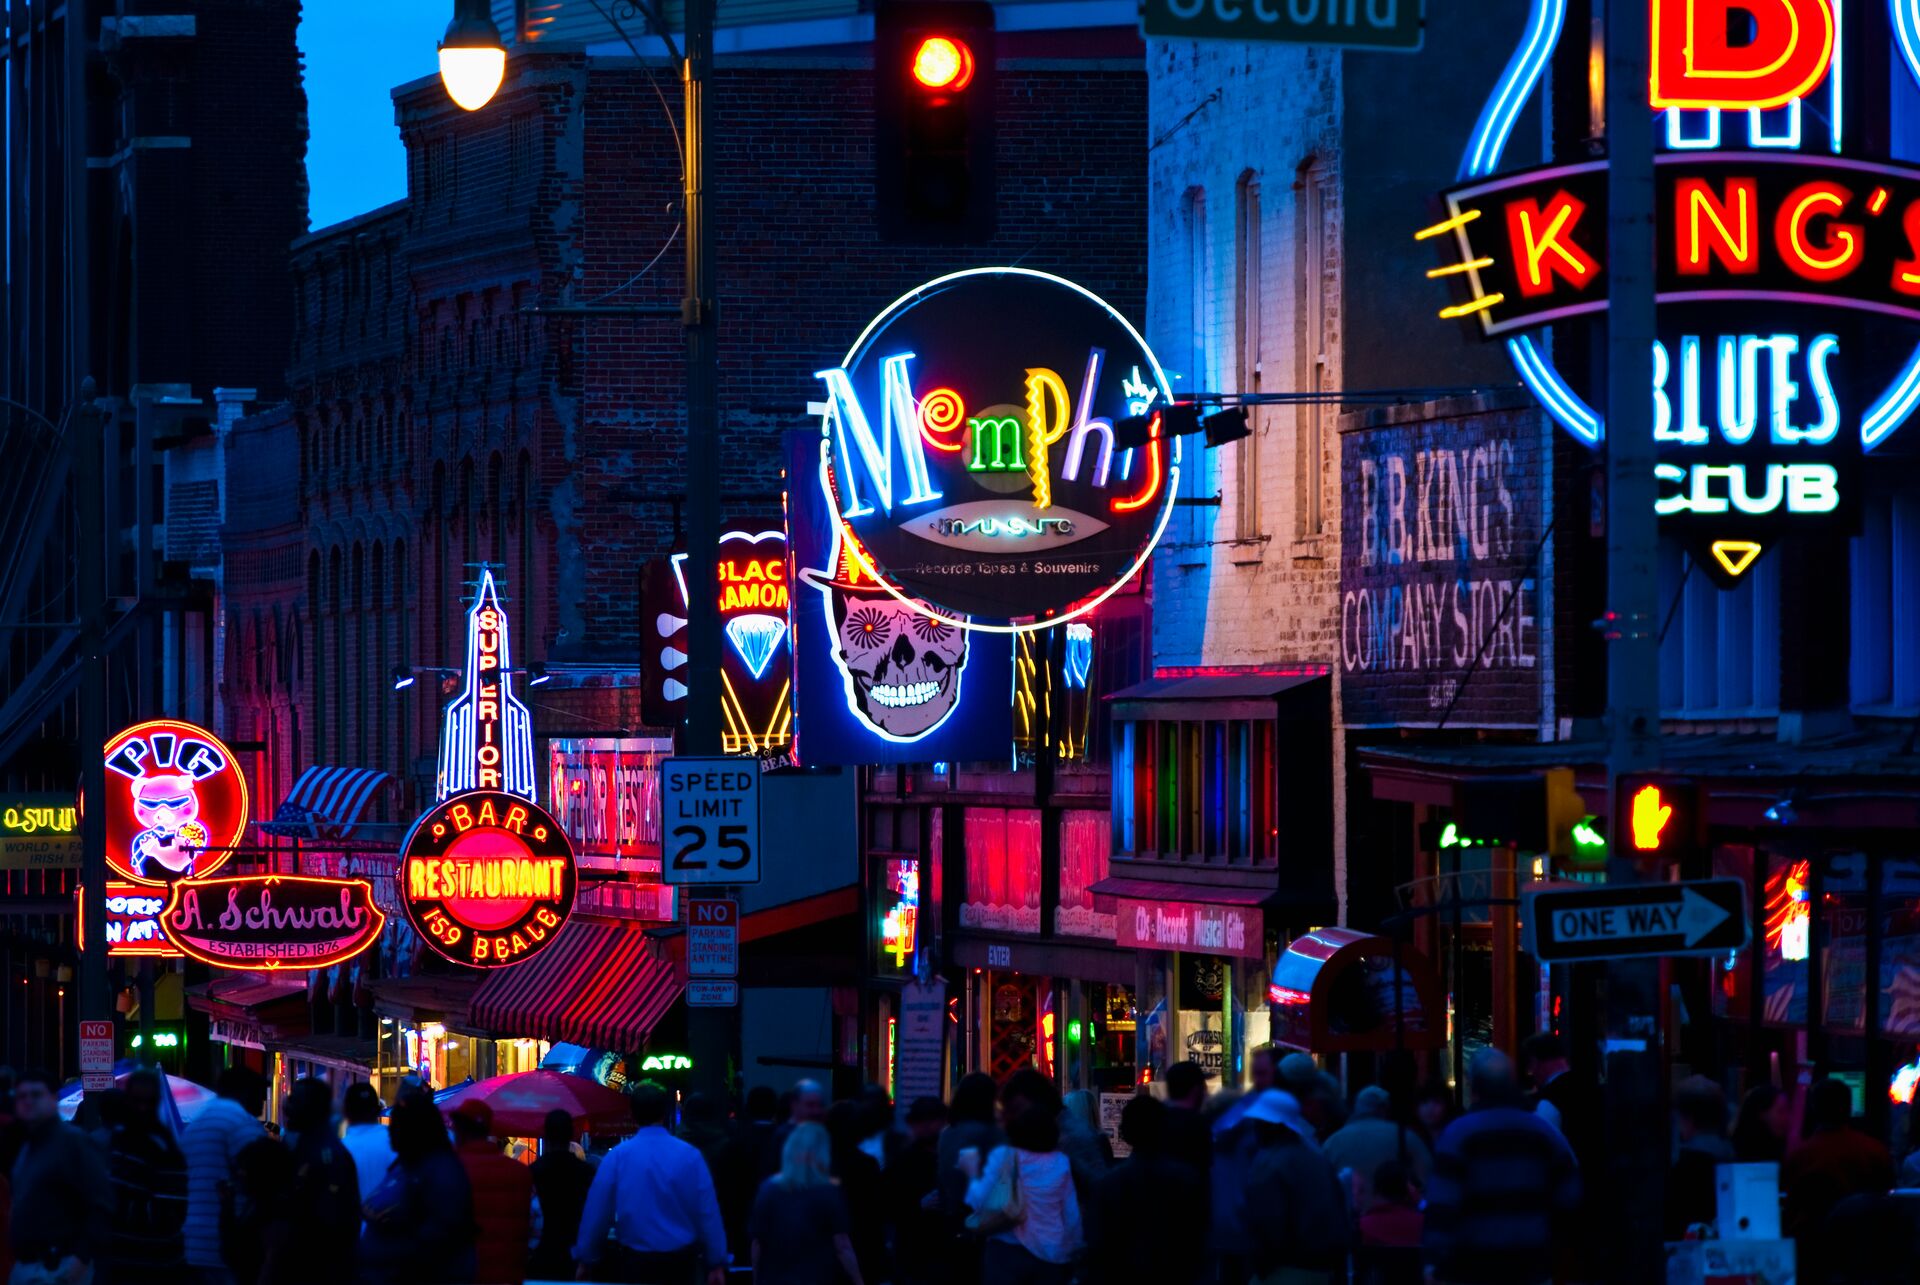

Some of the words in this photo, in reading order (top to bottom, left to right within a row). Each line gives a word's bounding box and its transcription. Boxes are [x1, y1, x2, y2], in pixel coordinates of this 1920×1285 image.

[1505, 176, 1920, 299] KNG'
[1653, 463, 1840, 514] CLUB
[718, 559, 785, 582] LAC
[1033, 560, 1101, 575] Souvenirs
[1341, 582, 1448, 672] COMPANY
[1452, 577, 1536, 670] STORE
[479, 609, 500, 789] SUPERIOR
[104, 732, 226, 781] PIG
[670, 772, 752, 793] SPEED
[451, 799, 528, 835] BAR
[679, 799, 743, 819] LIMIT
[672, 825, 752, 870] 25
[408, 858, 567, 900] RESTAURANT
[218, 887, 372, 931] Schwab
[697, 905, 729, 922] NO
[423, 909, 462, 946] 159
[473, 906, 559, 960] BEALE
[1560, 910, 1618, 939] ONE
[1627, 904, 1684, 934] WAY
[692, 928, 731, 939] PARKING
[208, 940, 306, 957] ESTABLISHED
[312, 941, 340, 954] 1876
[692, 943, 734, 953] STANDING
[692, 954, 734, 964] ANYTIME
[988, 944, 1011, 966] ENTER
[86, 1024, 107, 1037] NO
[82, 1040, 109, 1048] PARKING
